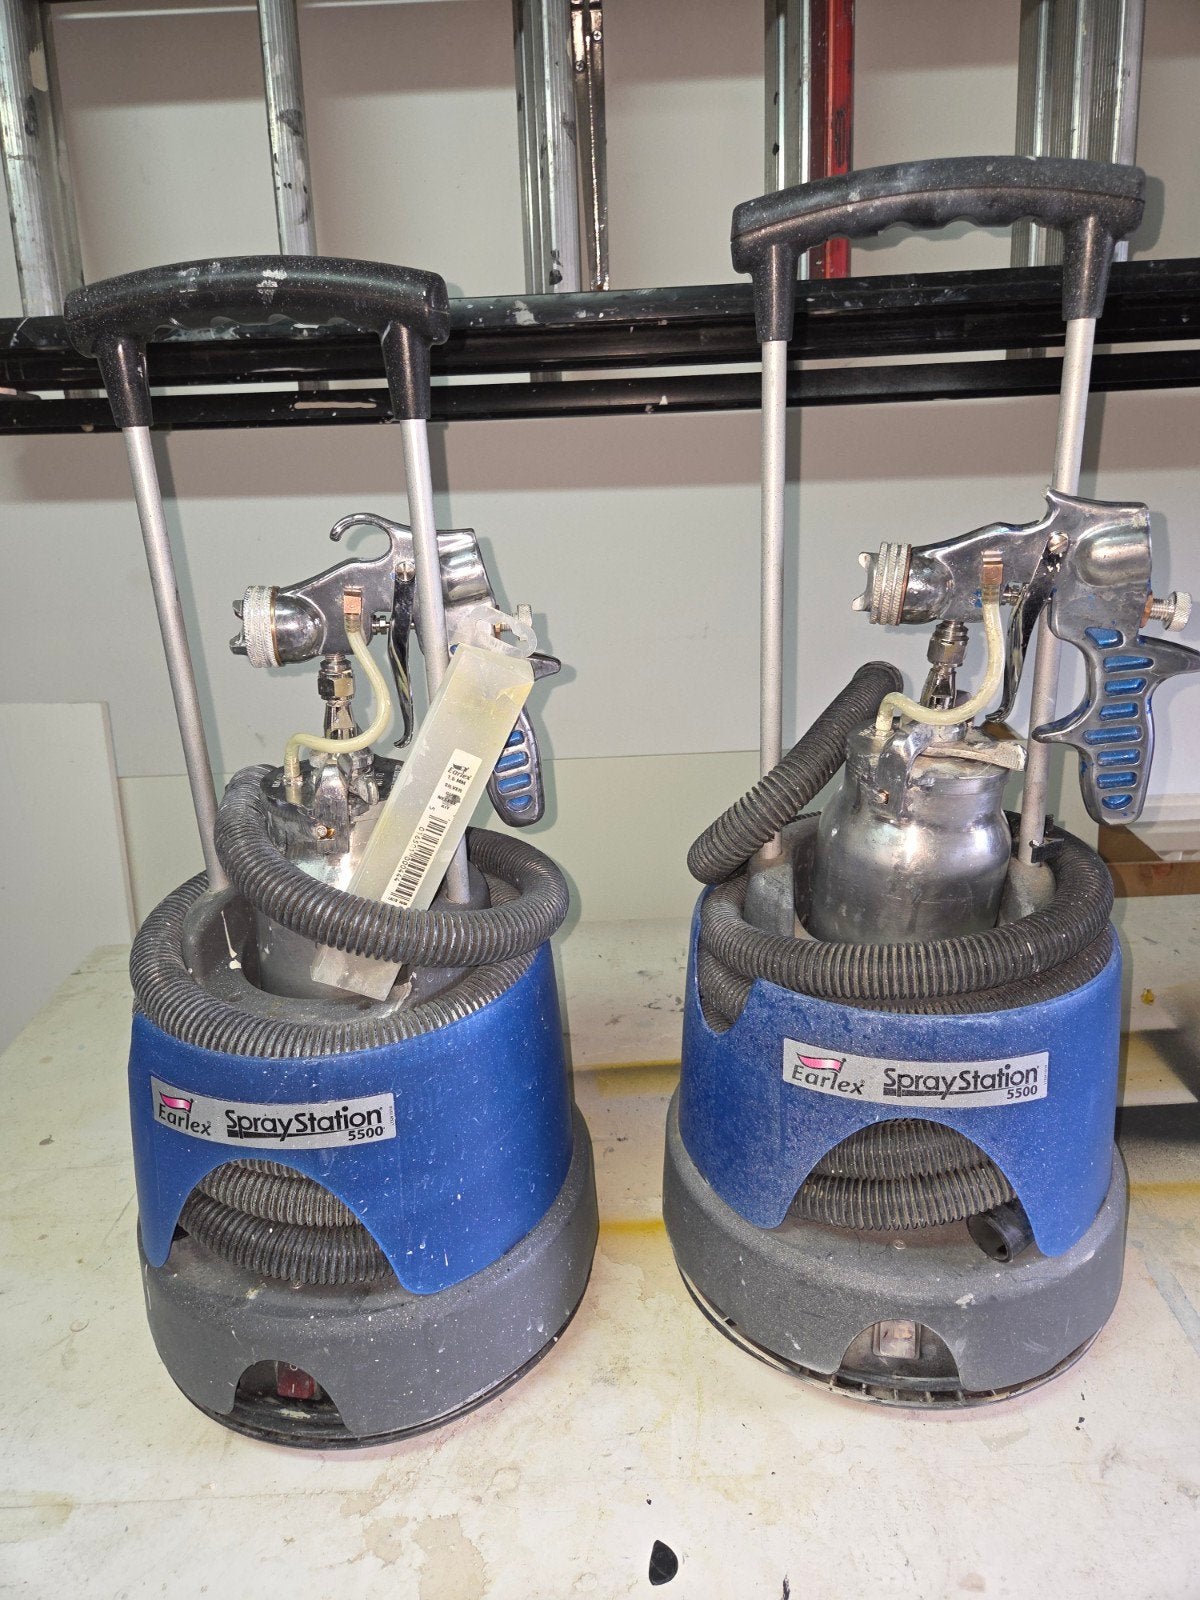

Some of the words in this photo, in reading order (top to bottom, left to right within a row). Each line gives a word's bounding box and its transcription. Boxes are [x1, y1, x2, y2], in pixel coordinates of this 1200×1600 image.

[792, 1064, 865, 1095] Earlex
[883, 1063, 1038, 1100] SprayStation
[1006, 1084, 1038, 1100] 5500
[159, 1105, 212, 1136] Earlex
[225, 1106, 383, 1141] SprayStation
[348, 1125, 384, 1141] 5500
